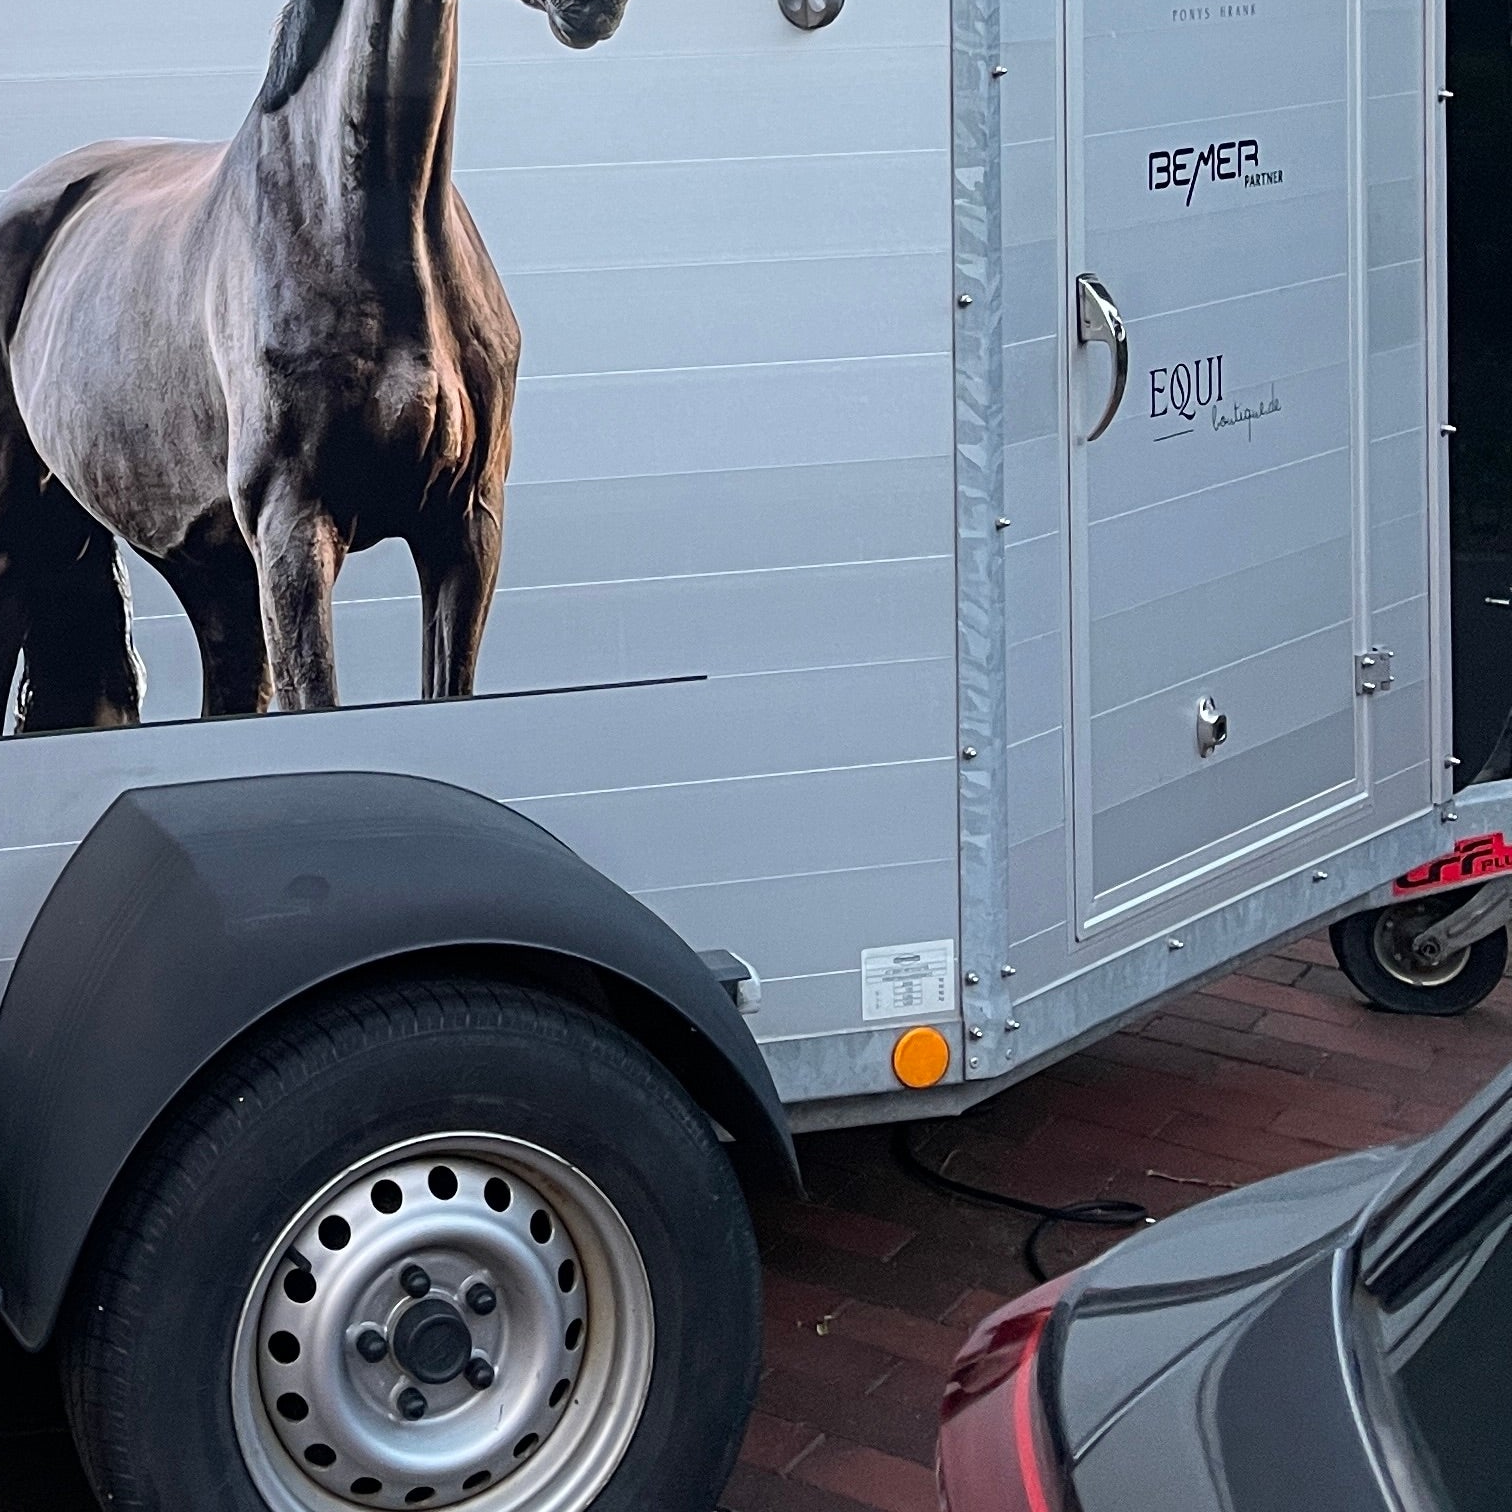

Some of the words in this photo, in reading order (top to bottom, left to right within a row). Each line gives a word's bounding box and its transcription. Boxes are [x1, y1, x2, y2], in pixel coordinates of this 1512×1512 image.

[1148, 139, 1260, 207] BEMER
[1244, 170, 1284, 189] PARTNER
[1149, 354, 1223, 421] EQUI
